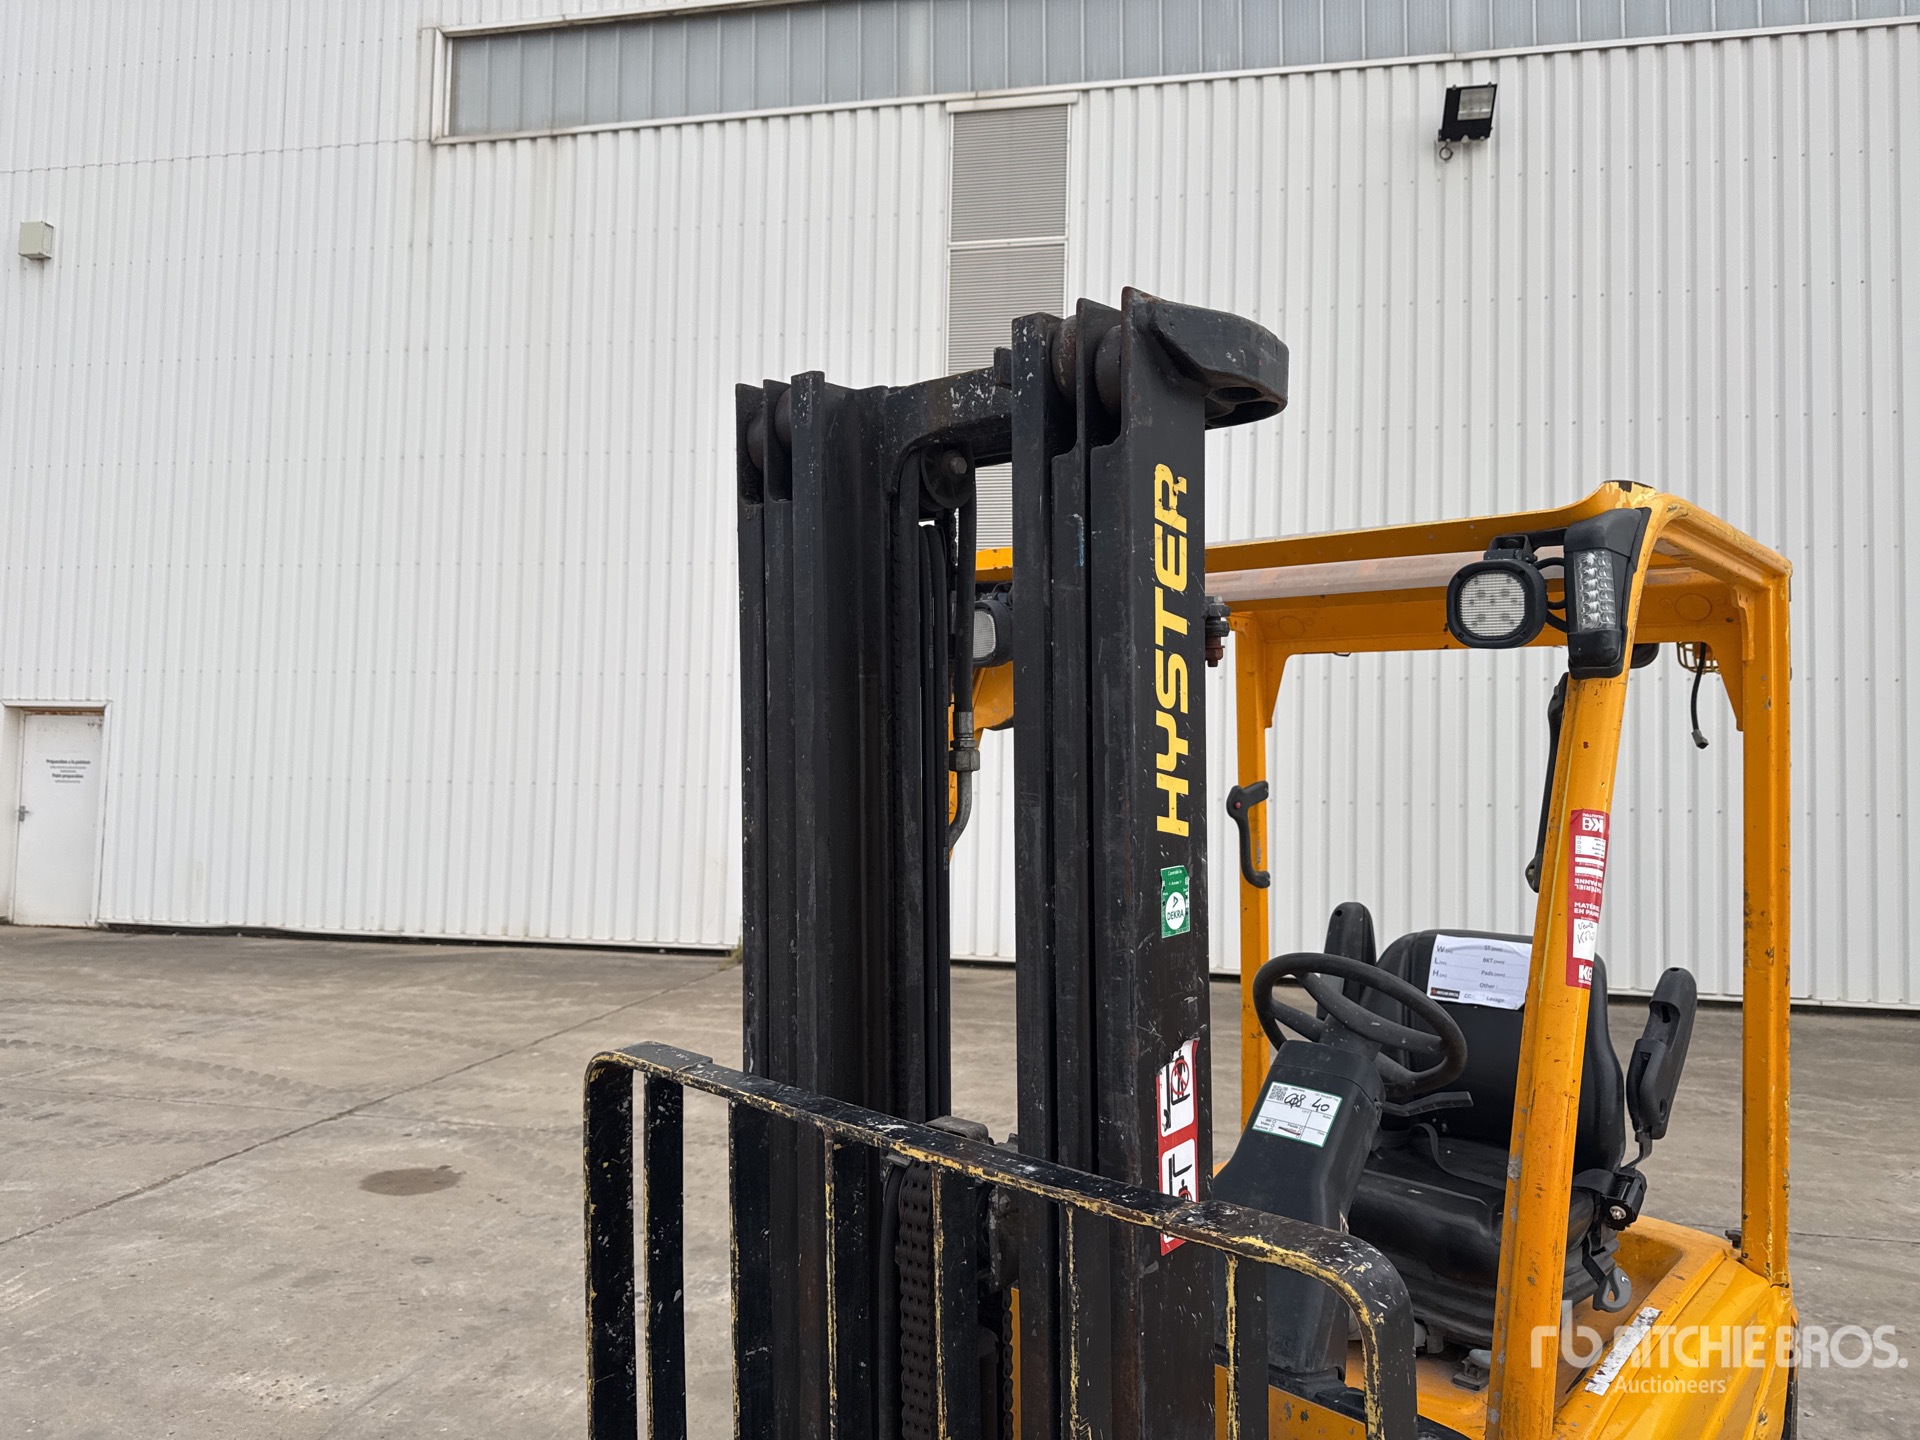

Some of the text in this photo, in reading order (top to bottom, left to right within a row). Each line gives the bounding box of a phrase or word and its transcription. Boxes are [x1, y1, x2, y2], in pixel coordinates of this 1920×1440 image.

[1154, 463, 1190, 838] HYSTER
[1167, 909, 1184, 921] DEKRA
[1574, 907, 1585, 915] EN
[1312, 1098, 1330, 1112] 40
